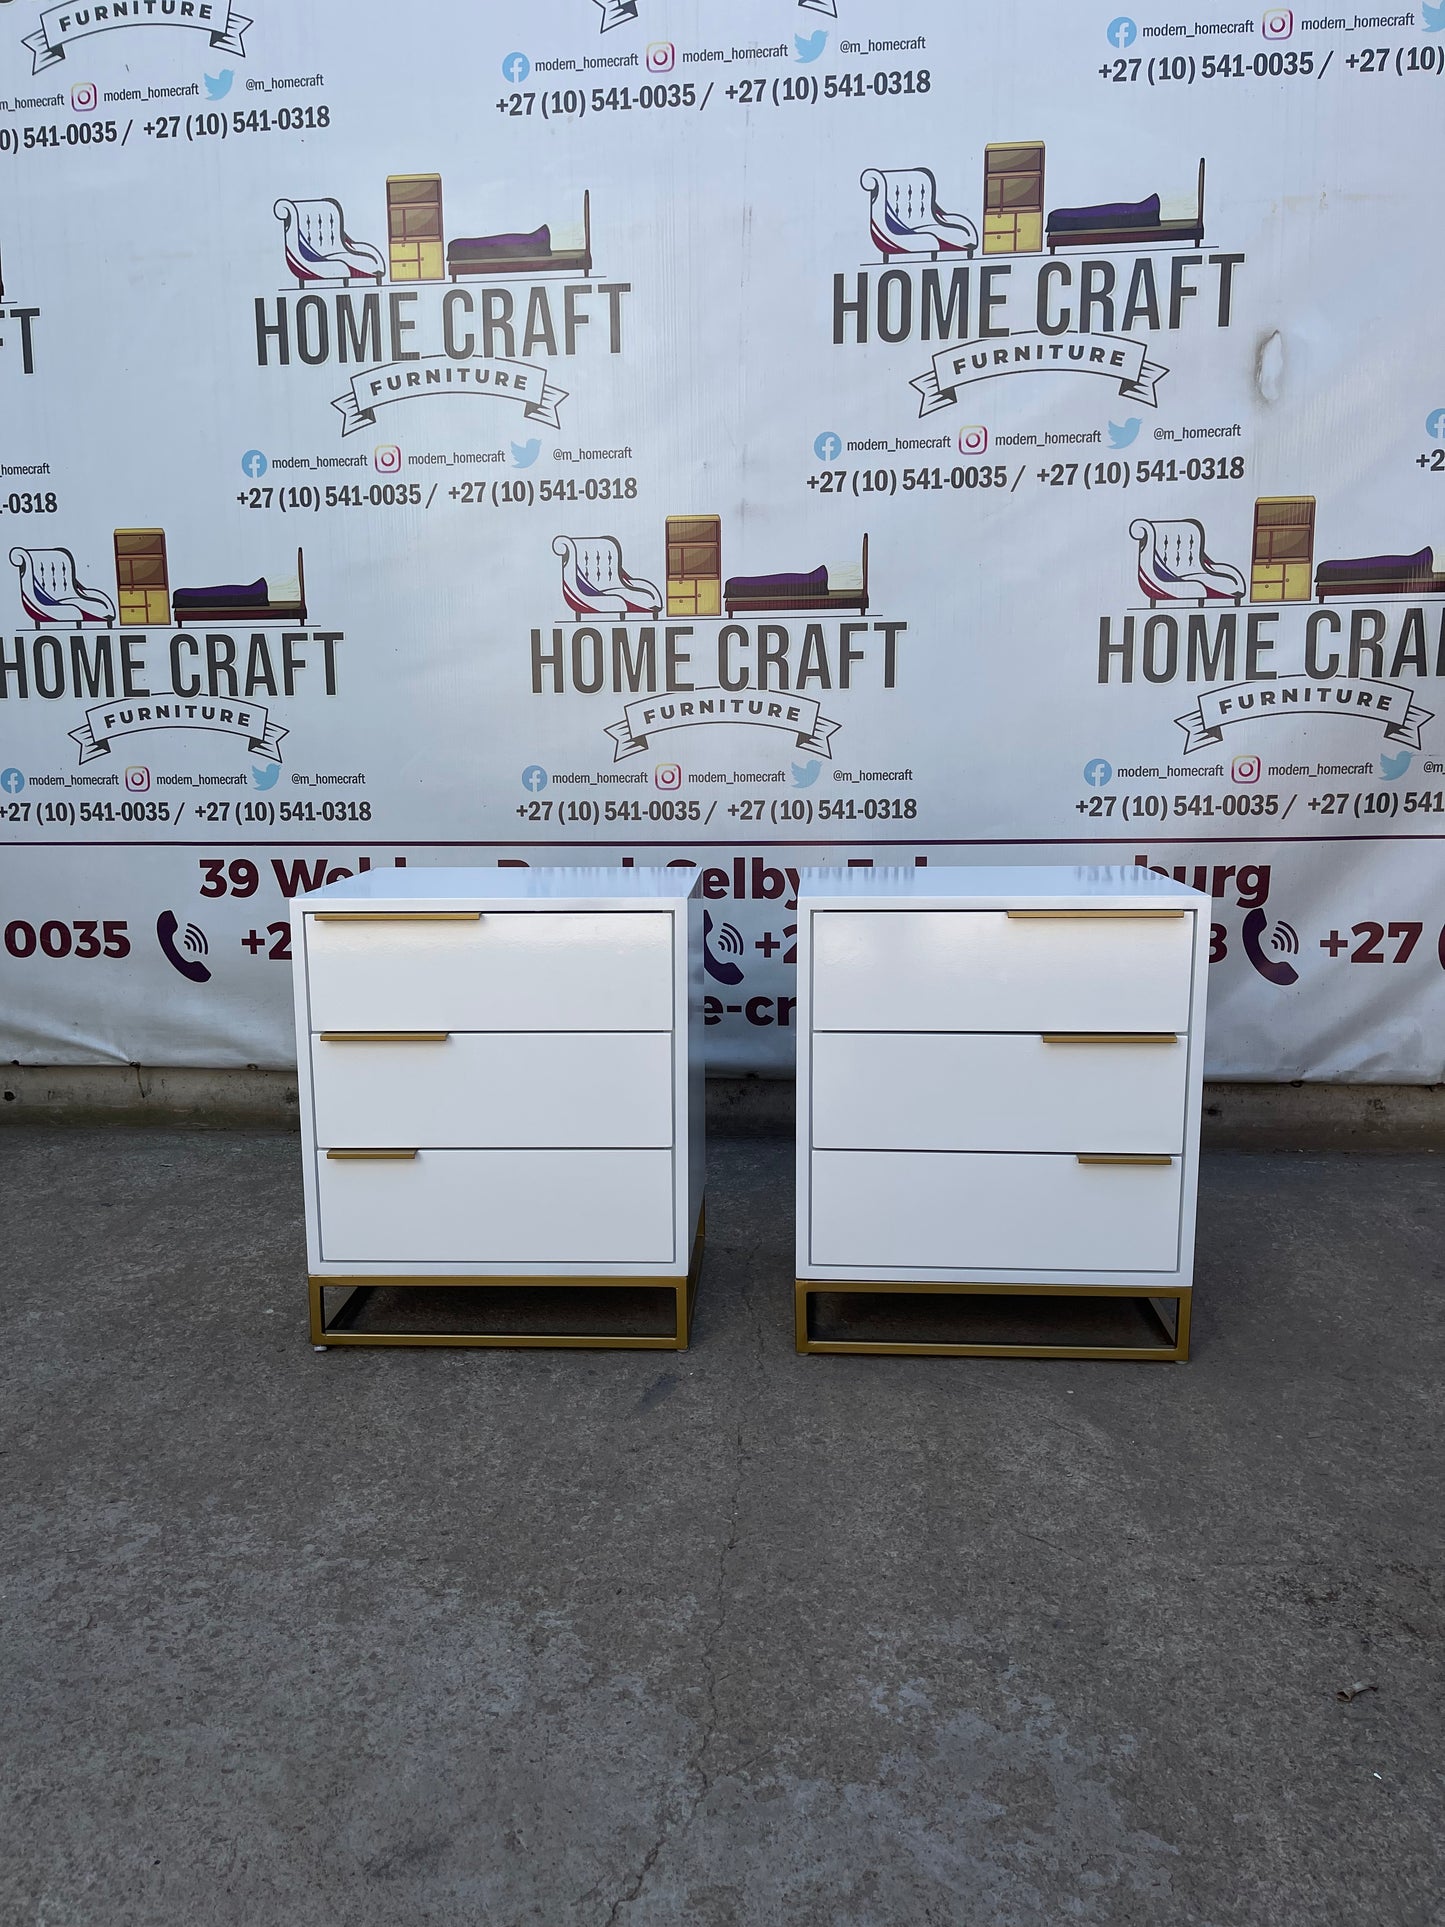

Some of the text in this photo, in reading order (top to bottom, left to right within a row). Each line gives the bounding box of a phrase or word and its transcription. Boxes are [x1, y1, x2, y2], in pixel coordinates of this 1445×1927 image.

[58, 0, 214, 32] FURNITURE
[840, 36, 925, 54] @m_homecraft
[1099, 59, 1141, 82] +27
[1148, 56, 1195, 85] (10)
[1202, 52, 1313, 78] 541-0035
[1346, 48, 1390, 72] +27
[1396, 46, 1444, 76] (10)
[246, 74, 324, 92] @m_homecraft
[496, 93, 535, 116] +27
[542, 90, 585, 119] (10)
[592, 84, 695, 111] 541-0035
[726, 79, 766, 103] +27
[773, 77, 818, 106] (10)
[824, 70, 930, 98] 541-0318
[24, 121, 117, 148] 541-0035
[144, 116, 180, 138] +27
[186, 113, 227, 141] (10)
[233, 106, 330, 133] 541-0318
[833, 251, 1245, 347] HOME CRAFT
[255, 281, 631, 368] HOME CRAFT
[952, 344, 1123, 374] FURNITURE
[370, 368, 525, 396] FURNITURE
[1154, 424, 1241, 441] @m_homecraft
[553, 447, 632, 462] @m_homecraft
[807, 471, 846, 492] +27
[853, 470, 896, 496] (10)
[903, 466, 1007, 490] 541-0035
[1037, 464, 1078, 486] +27
[1084, 462, 1130, 489] (10)
[1136, 457, 1244, 482] 541-0318
[237, 488, 273, 508] +27
[280, 487, 320, 512] (10)
[326, 484, 421, 506] 541-0035
[449, 482, 486, 503] +27
[492, 481, 534, 507] (10)
[540, 478, 637, 501] 541-0318
[531, 619, 907, 697] HOME CRAFT
[1098, 613, 1279, 686] HOME
[0, 632, 344, 700] HOME CRAFT
[104, 704, 251, 729] FURNITURE
[643, 699, 802, 726] FURNITURE
[1219, 687, 1393, 716] FURNITURE
[292, 773, 365, 786] @m_homecraft
[834, 769, 912, 783] @m_homecraft
[37, 803, 75, 825] (10)
[80, 802, 169, 821] 541-0035
[195, 802, 230, 821] +27
[236, 802, 274, 825] (10)
[280, 802, 371, 821] 541-0318
[516, 801, 553, 820] +27
[559, 801, 599, 825] (10)
[605, 801, 700, 820] 541-0035
[728, 800, 765, 820] +27
[771, 800, 813, 824] (10)
[818, 799, 917, 819] 541-0318
[1076, 796, 1116, 816] +27
[1123, 796, 1167, 821] (10)
[1174, 795, 1278, 816] 541-0035
[1308, 794, 1349, 814] +27
[1354, 793, 1398, 818] (10)
[200, 859, 259, 898] 39
[5, 920, 130, 958] 0035
[1320, 922, 1423, 963] +27
